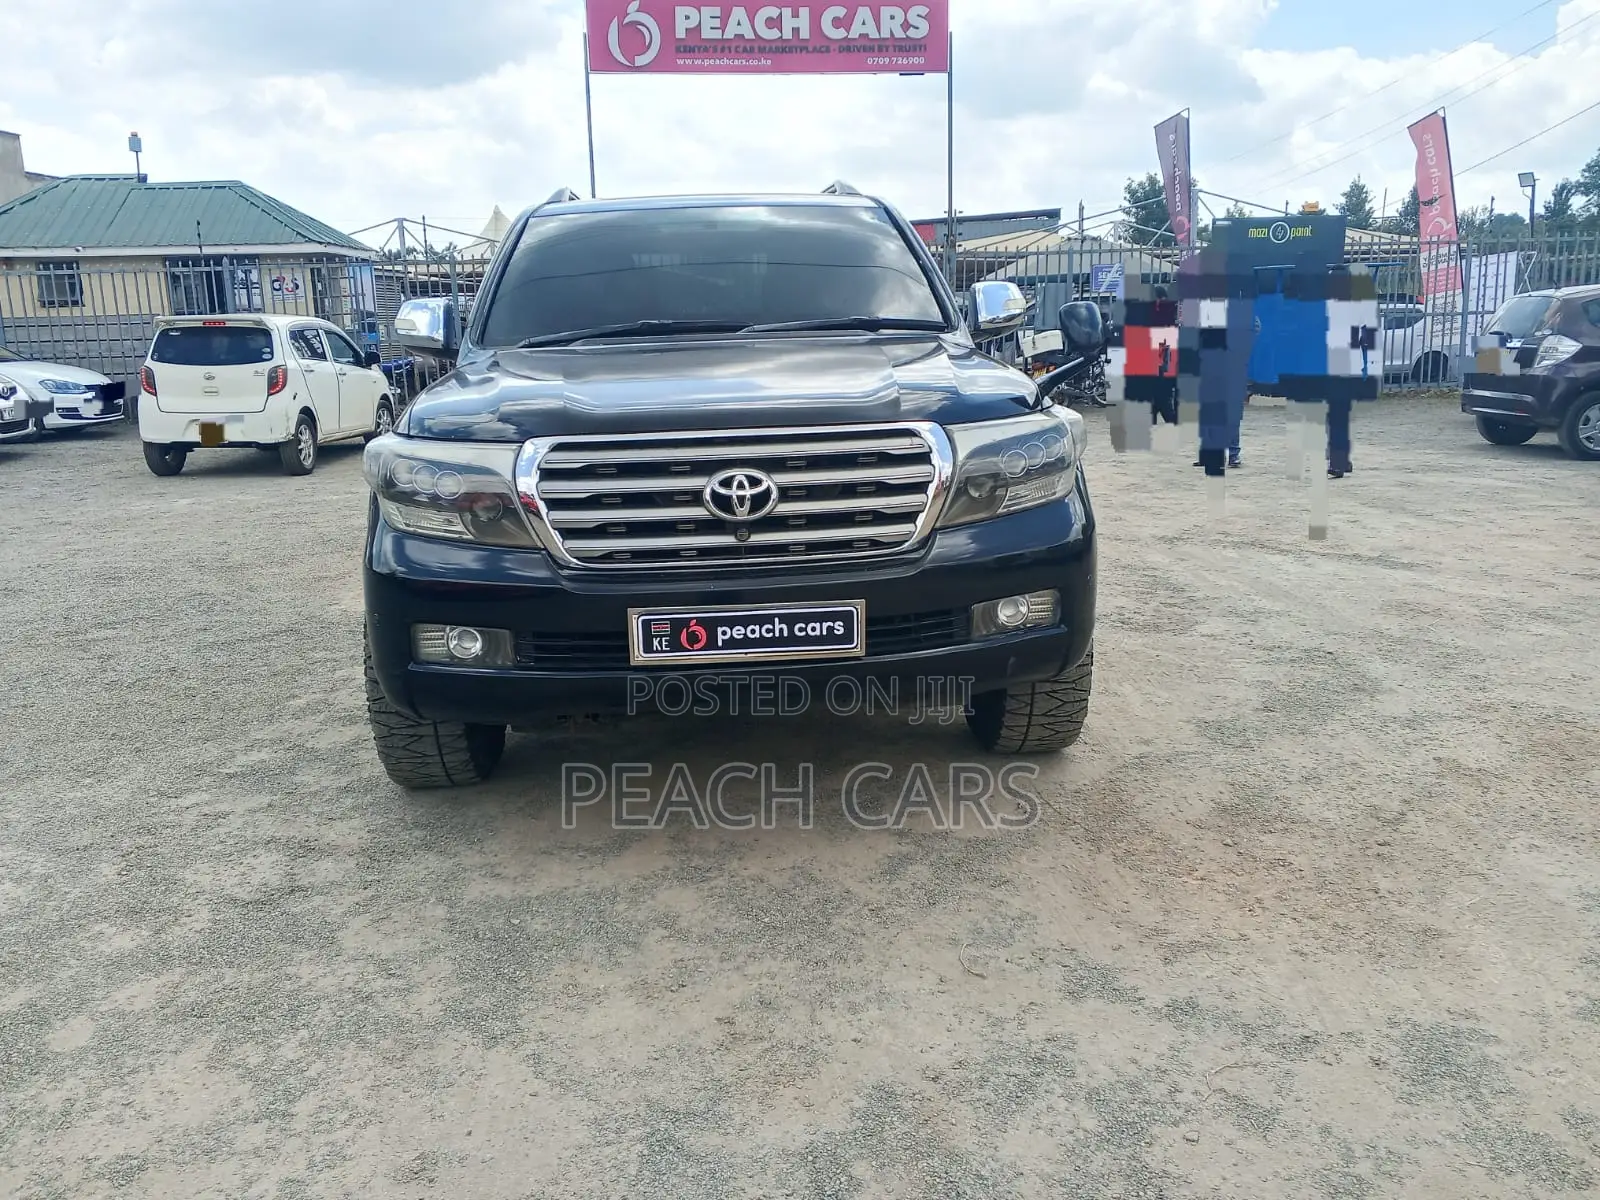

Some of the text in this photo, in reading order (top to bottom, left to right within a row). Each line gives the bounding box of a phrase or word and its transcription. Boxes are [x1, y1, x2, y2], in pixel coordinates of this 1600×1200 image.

[674, 6, 930, 40] PEACH CARS
[734, 44, 755, 54] CAR
[757, 44, 830, 54] MARKETPLACE
[838, 44, 875, 53] DRIVEN
[877, 44, 890, 53] BY
[676, 56, 772, 66] www.peachcars.co.ke
[867, 56, 925, 65] 0709 726900
[717, 617, 845, 647] peach cars
[653, 637, 670, 651] KE
